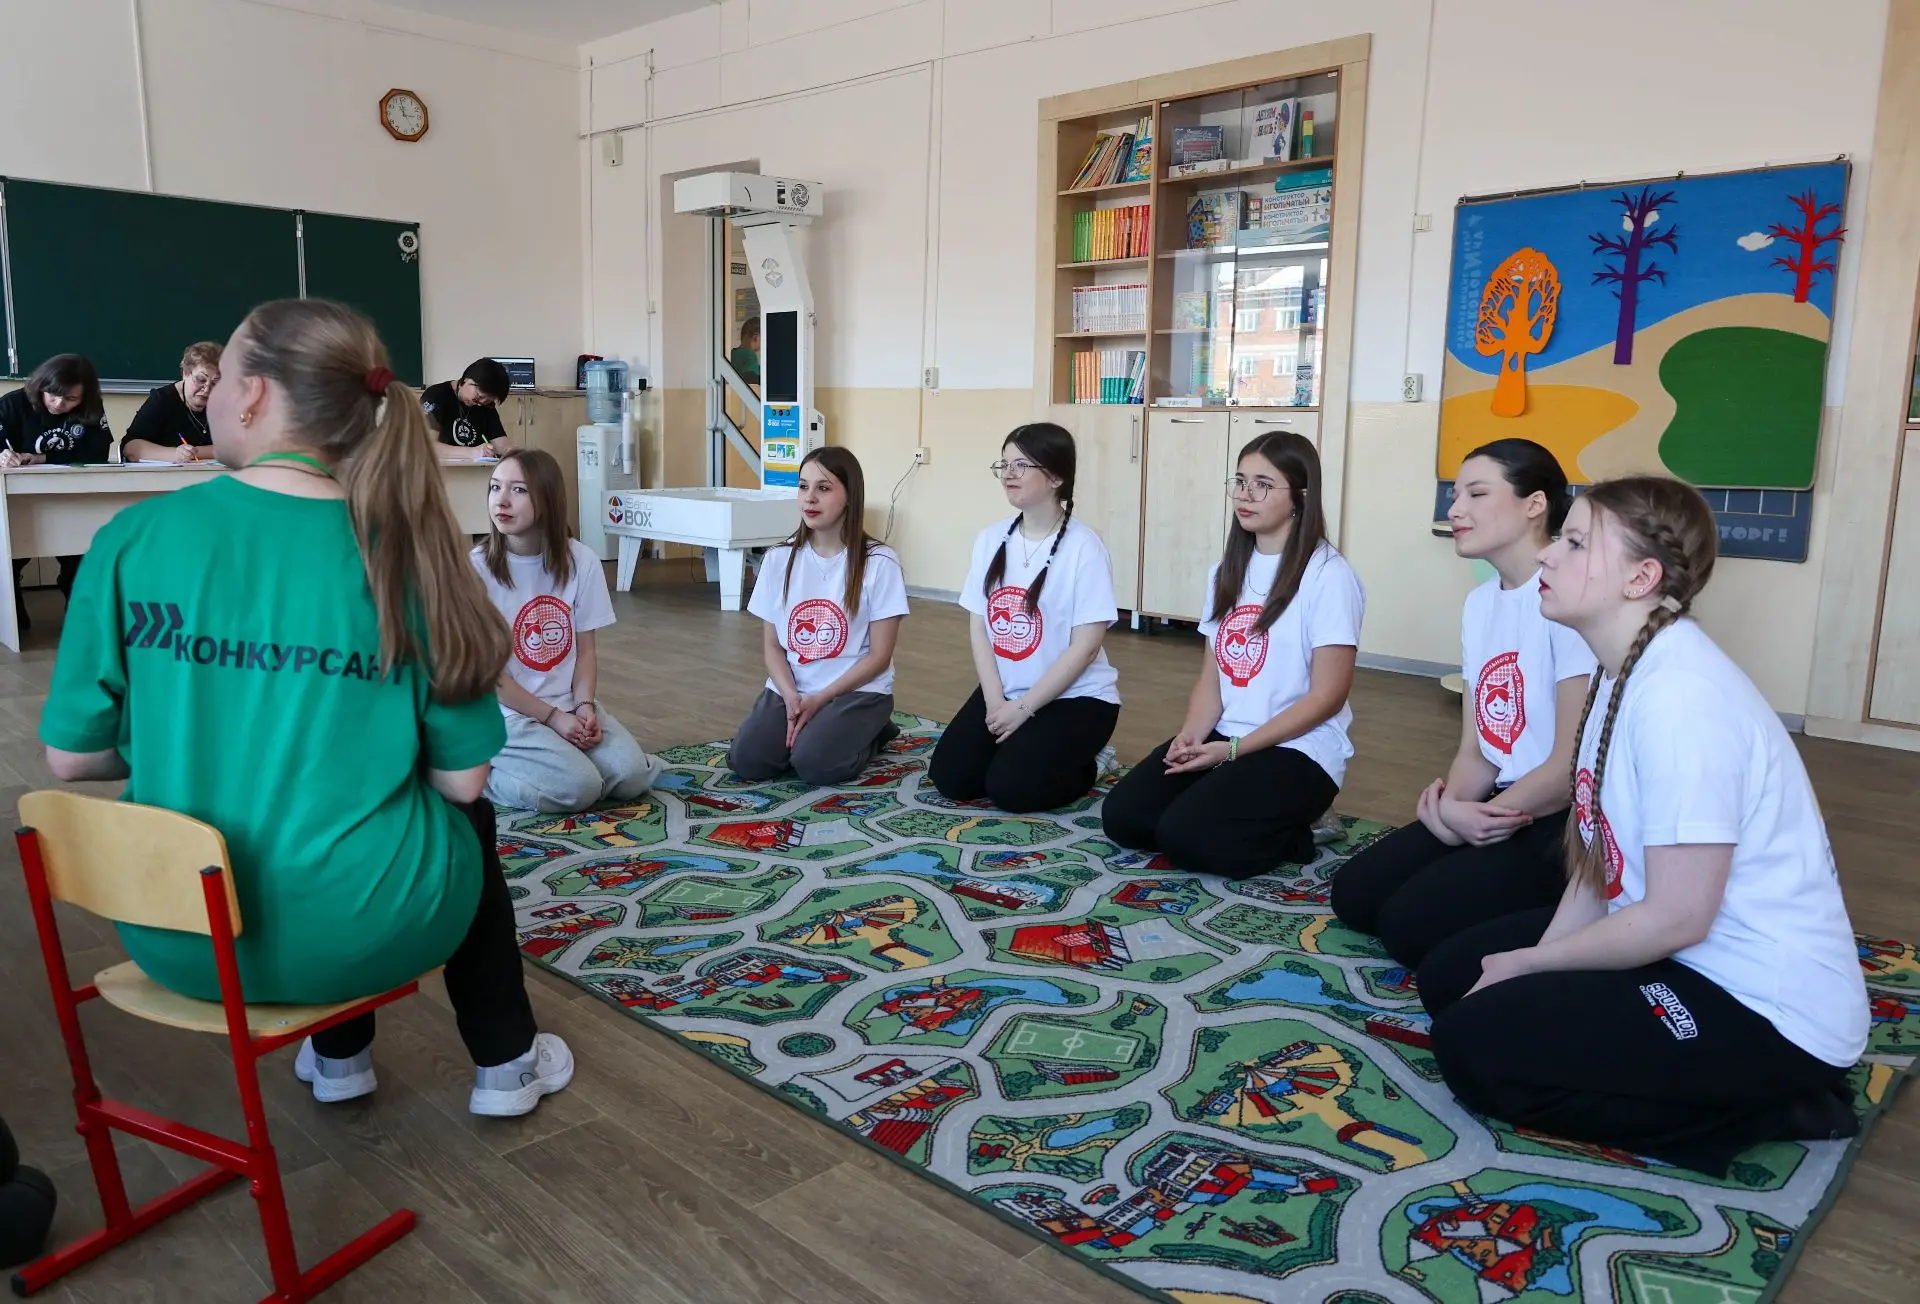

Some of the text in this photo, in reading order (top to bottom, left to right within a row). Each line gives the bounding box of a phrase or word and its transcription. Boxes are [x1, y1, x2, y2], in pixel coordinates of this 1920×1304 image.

[1264, 198, 1310, 210] ИГОЛЬЧАТЫЙ
[624, 509, 653, 528] BOX
[1646, 982, 1698, 1039] SCULPTOR
